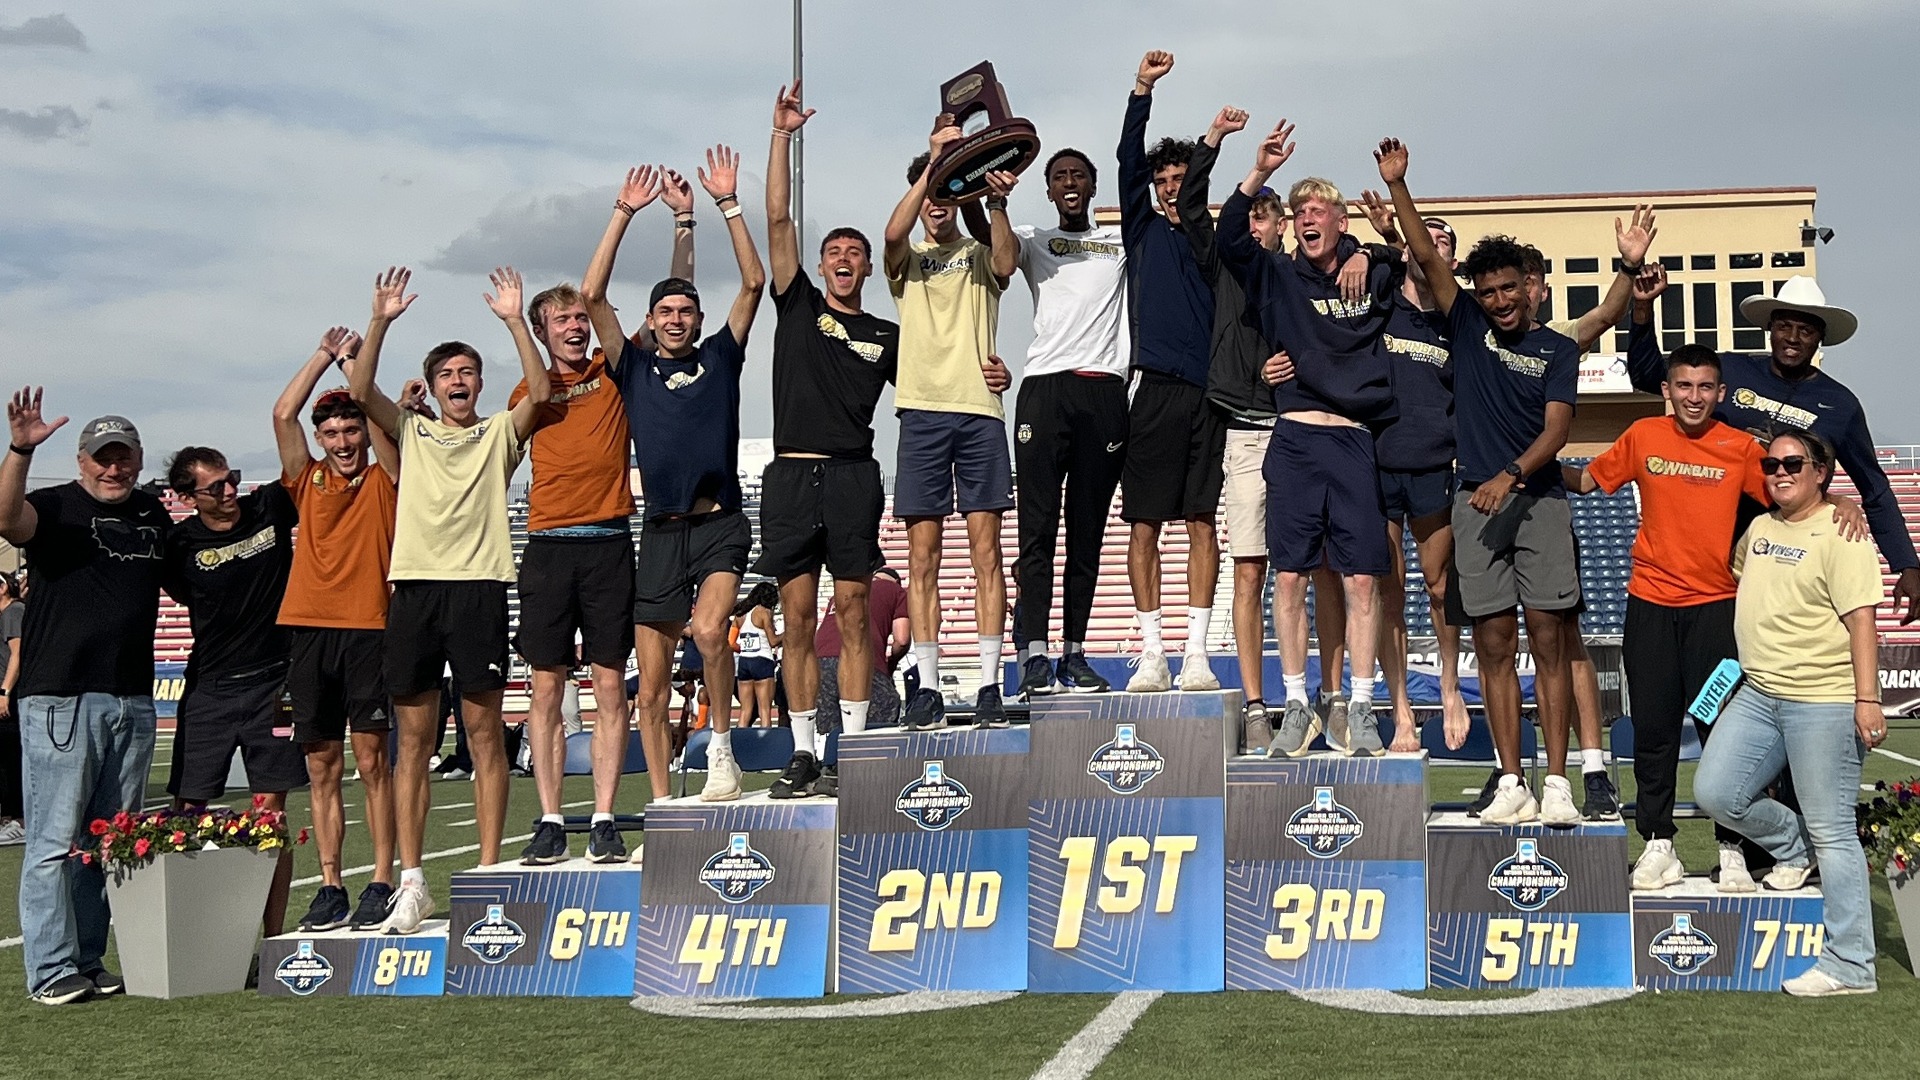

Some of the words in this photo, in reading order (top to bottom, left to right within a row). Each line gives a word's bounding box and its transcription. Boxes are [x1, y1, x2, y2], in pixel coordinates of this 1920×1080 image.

[965, 147, 1019, 182] CHAMPIONSHIPS
[1754, 395, 1818, 425] WINGATE
[1662, 460, 1726, 480] WINGATE
[1878, 670, 1920, 689] RACK
[1090, 760, 1162, 771] CHAMPIONSHIPS
[898, 796, 970, 809] CHAMPIONSHIPS
[1287, 823, 1361, 836] CHAMPIONSHIPS
[702, 868, 773, 881] CHAMPIONSHIPS
[1490, 875, 1566, 888] CHAMPIONSHIPS
[1053, 835, 1198, 949] 1ST
[868, 869, 1002, 952] 2ND
[1264, 883, 1385, 960] 3RD
[465, 935, 524, 944] CHAMPIONSHIPS
[549, 908, 631, 960] 6TH
[678, 914, 787, 984] 4TH
[1753, 920, 1824, 968] 7TH
[1480, 918, 1579, 982] 5TH
[1651, 945, 1715, 955] CHAMPIONSHIPS
[374, 948, 432, 985] 8TH
